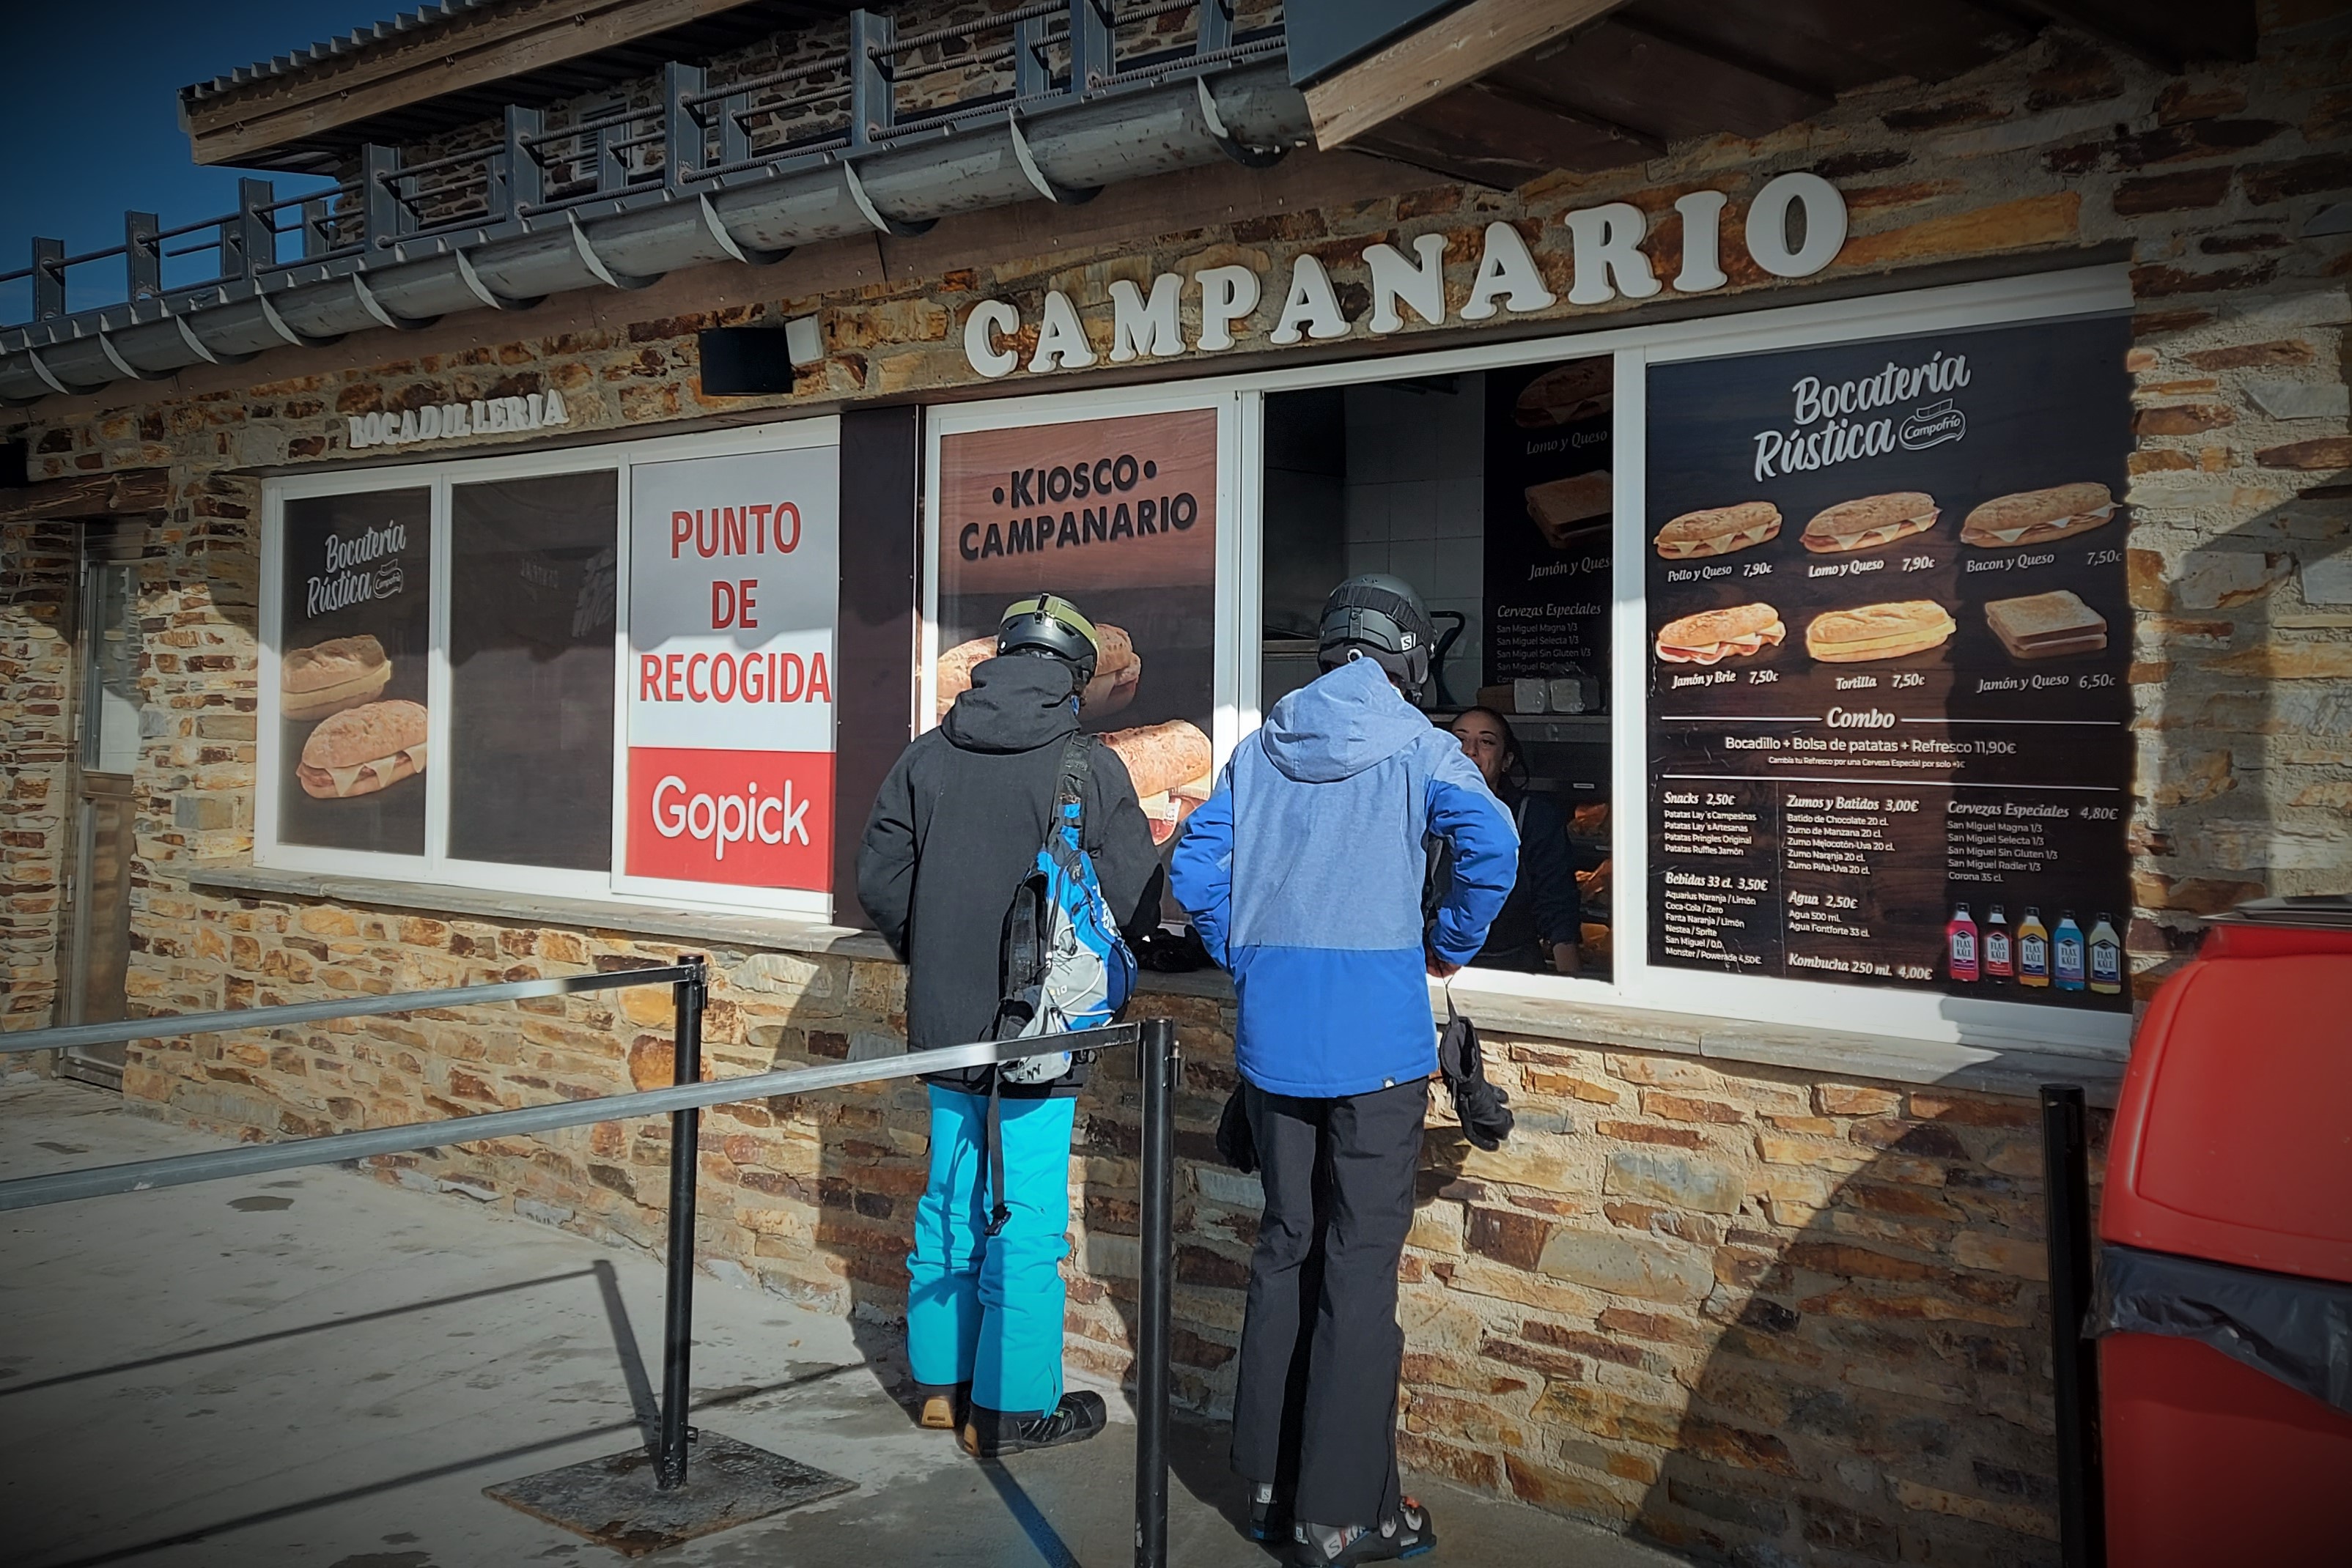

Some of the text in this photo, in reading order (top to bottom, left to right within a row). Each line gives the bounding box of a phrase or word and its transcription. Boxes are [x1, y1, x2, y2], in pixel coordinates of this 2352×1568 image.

[963, 171, 1848, 379] CAMPANARIO
[1792, 350, 1972, 425] Bocatería
[348, 388, 569, 448] BOCADILLERIA
[1527, 430, 1607, 455] Lomo y Queso
[1754, 415, 1961, 482] Rústica Campofrío
[671, 501, 801, 559] PUNTO
[959, 492, 1197, 561] CAMPANARIO
[325, 519, 406, 573] Bocatería
[1527, 561, 1568, 581] Jamón
[1569, 561, 1578, 576] y
[1808, 566, 1838, 577] Lomo
[1839, 564, 1848, 576] y
[1850, 559, 1884, 574] Queso
[1966, 560, 2004, 572] Bacon
[2005, 558, 2014, 571] y
[2018, 553, 2054, 569] Queso
[1667, 569, 1692, 582] Pollo
[1693, 571, 1700, 581] y
[1703, 565, 1732, 579] Queso
[307, 570, 372, 618] Rústica
[712, 579, 759, 629] DE
[1497, 603, 1601, 618] Cervezas Especiales
[640, 652, 832, 703] RECOGIDA
[1671, 673, 1704, 689] Jamón
[1704, 674, 1713, 687] y
[1714, 670, 1736, 684] Brie
[1835, 676, 1877, 690] Tortilla
[1976, 677, 2019, 693] Jamón
[2019, 678, 2029, 691] y
[2032, 675, 2069, 689] Queso
[1827, 706, 1895, 729] Combo
[1725, 736, 2017, 755] Bocadillo + Bolsa de patatas + Refresco 11,90€
[1663, 791, 1736, 806] Snacks 2,50€
[1786, 794, 1920, 813] Zumos y Batidos 3,00€
[652, 775, 810, 861] Gopick
[1664, 810, 1691, 818] Patatas
[1787, 813, 1813, 823] Batido
[1814, 815, 1824, 824] de
[1826, 815, 1866, 825] Chocolate
[1868, 817, 1879, 825] 20
[1947, 801, 2119, 820] Cervezas Especiales 4,80€
[1664, 821, 1691, 830] Patatas
[1787, 826, 1811, 834] Zumo
[1812, 826, 1822, 835] de
[1824, 828, 1860, 837] Manzana
[1861, 829, 1872, 837] 20
[1966, 821, 1997, 832] Miguel
[1998, 823, 2029, 833] Magna
[2031, 824, 2043, 832] 1/3
[1664, 832, 1752, 845] Patatas Pringles Original
[1948, 834, 2044, 846] San Miguel Selecta 1/3
[1665, 844, 1692, 853] Patatas
[1787, 849, 1812, 858] Zumo
[1844, 853, 1855, 861] 20
[1966, 847, 1997, 857] Miguel
[1998, 848, 2013, 857] Sin
[2015, 849, 2044, 859] Gluten
[2046, 851, 2058, 859] 1/3
[1948, 859, 2041, 871] San Miguel Radler 1/3
[1665, 871, 1706, 886] Bebidas
[1707, 876, 1719, 887] 33
[1736, 878, 1769, 891] 3,50€
[1948, 871, 1979, 881] Corona
[1981, 873, 1992, 881] 35
[1665, 902, 1701, 912] Coca-Cola
[1706, 905, 1723, 914] Zero
[1788, 891, 1858, 909] Agua 2,50€
[1687, 915, 1715, 926] Naranja
[1788, 910, 1810, 920] Agua
[1810, 913, 1826, 921] 500
[1955, 939, 1971, 949] FLAX
[1991, 942, 2006, 951] FLAX
[2025, 944, 2041, 953] FLAX
[2061, 947, 2077, 956] FLAX
[2097, 950, 2113, 959] FLAX
[1788, 953, 1849, 972] Kombucha
[1851, 961, 1873, 975] 250
[1898, 966, 1933, 980] 4,00€
